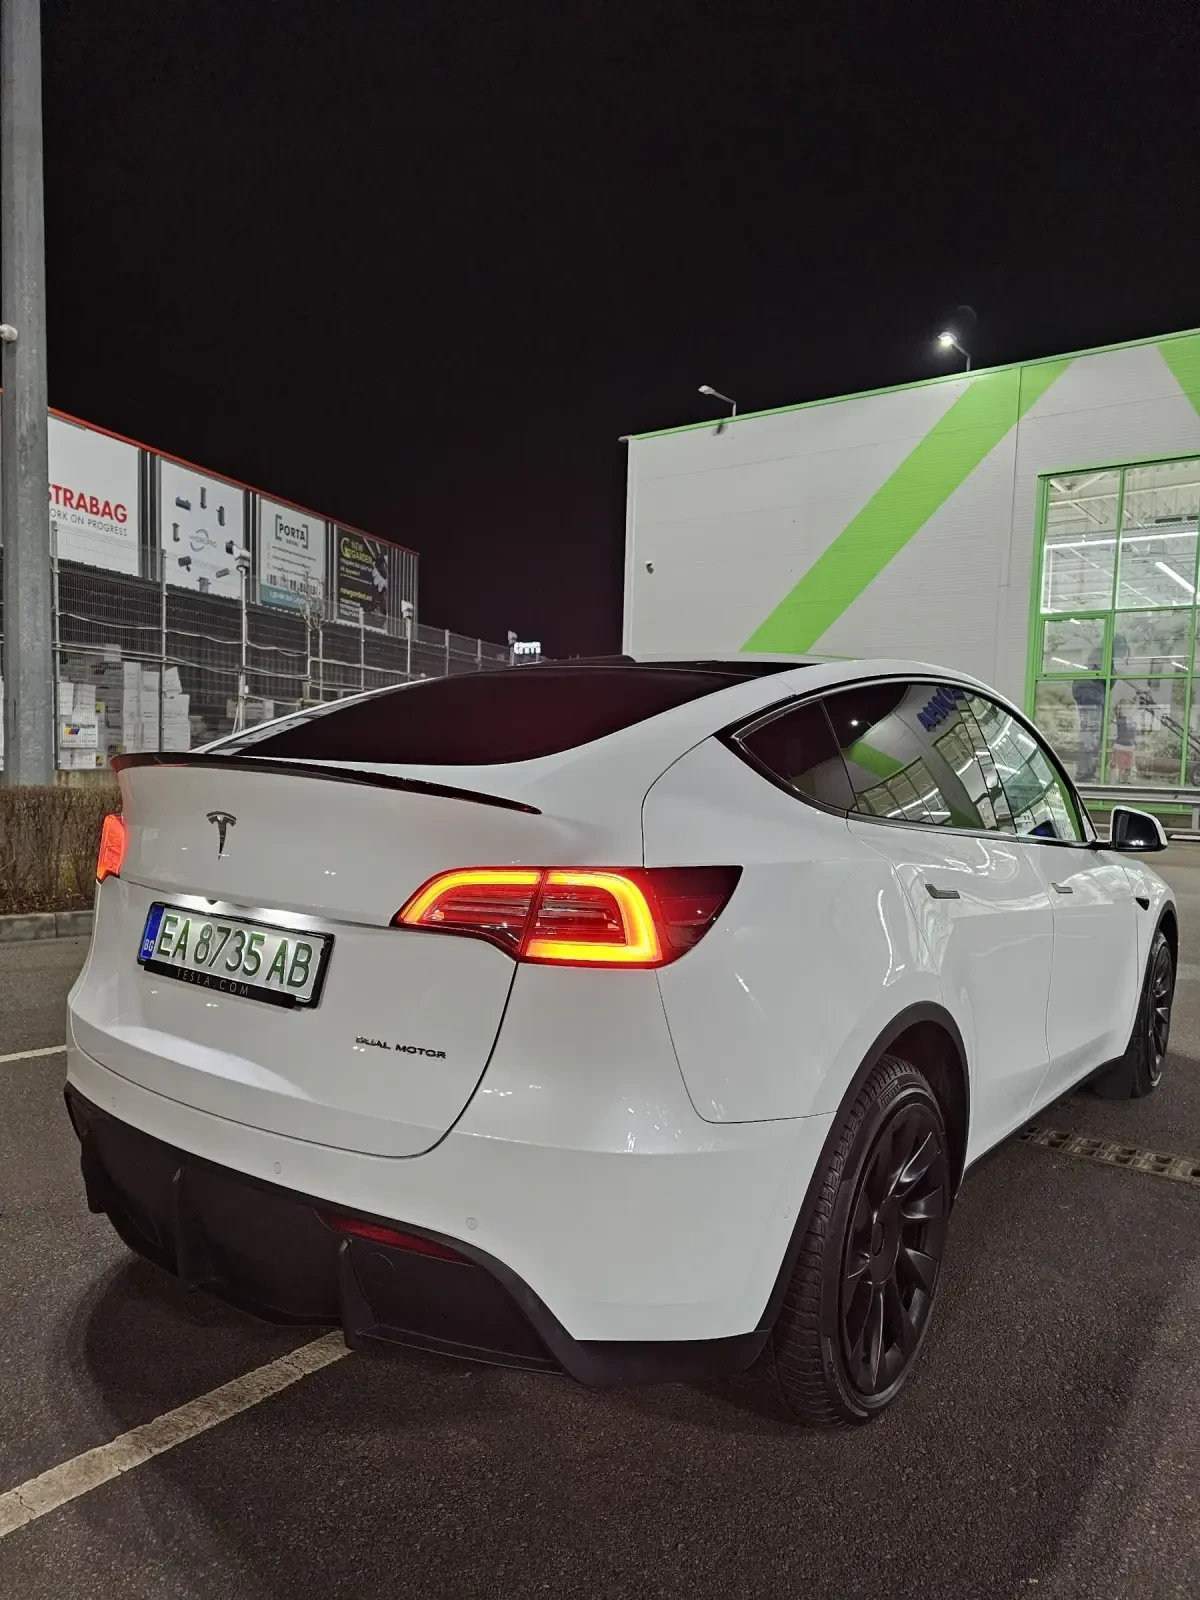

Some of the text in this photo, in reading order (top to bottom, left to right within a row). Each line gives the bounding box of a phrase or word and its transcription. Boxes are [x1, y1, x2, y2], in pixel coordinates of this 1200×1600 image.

[49, 508, 127, 536] ORK ON PROGRESS
[279, 523, 305, 542] PORTA
[143, 937, 155, 952] BG
[156, 915, 313, 989] EA 8735 AB
[355, 1035, 447, 1060] DUAL MOTOR
